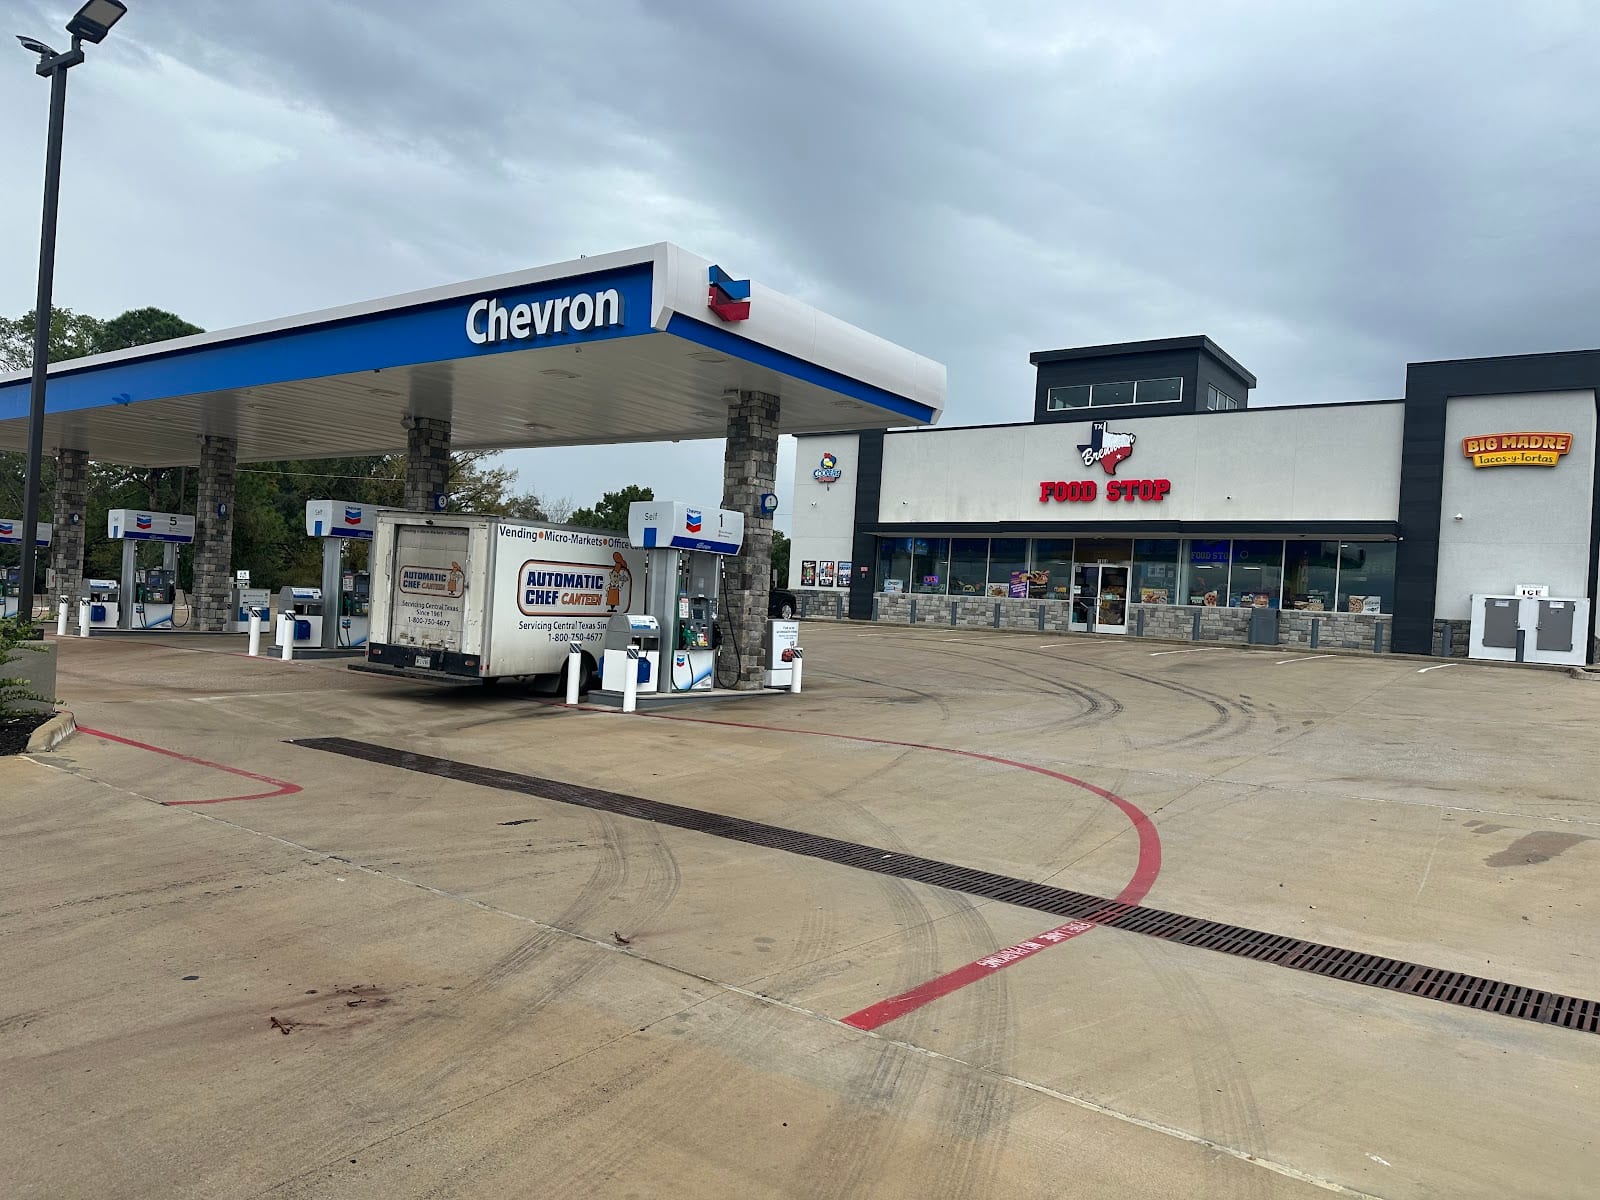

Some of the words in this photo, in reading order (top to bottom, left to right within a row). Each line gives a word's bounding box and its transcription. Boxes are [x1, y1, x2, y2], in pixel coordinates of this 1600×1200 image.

[465, 287, 620, 345] Chevron
[1467, 437, 1498, 453] BIG
[1501, 435, 1567, 450] MADRE
[1479, 455, 1509, 464] Tacos
[1520, 452, 1553, 463] Tortas
[1039, 480, 1097, 503] FOOD
[1106, 478, 1171, 503] STOP
[440, 495, 446, 505] 3
[169, 516, 177, 526] 5
[644, 512, 658, 521] Self
[719, 513, 724, 528] 1
[499, 525, 538, 543] Vending
[544, 530, 602, 547] Micro-Markets
[607, 537, 629, 550] Office
[403, 571, 447, 582] AUTOMATIC
[526, 571, 604, 590] AUTOMATIC
[403, 580, 421, 589] CHEF
[525, 589, 559, 605] CHEF
[561, 593, 602, 606] CANTEEN
[402, 600, 425, 610] Servicing
[425, 602, 444, 610] Central
[518, 621, 552, 632] Servicing
[553, 622, 578, 630] Central
[578, 622, 596, 630] Texas
[548, 633, 603, 642] 1-800-750-4677
